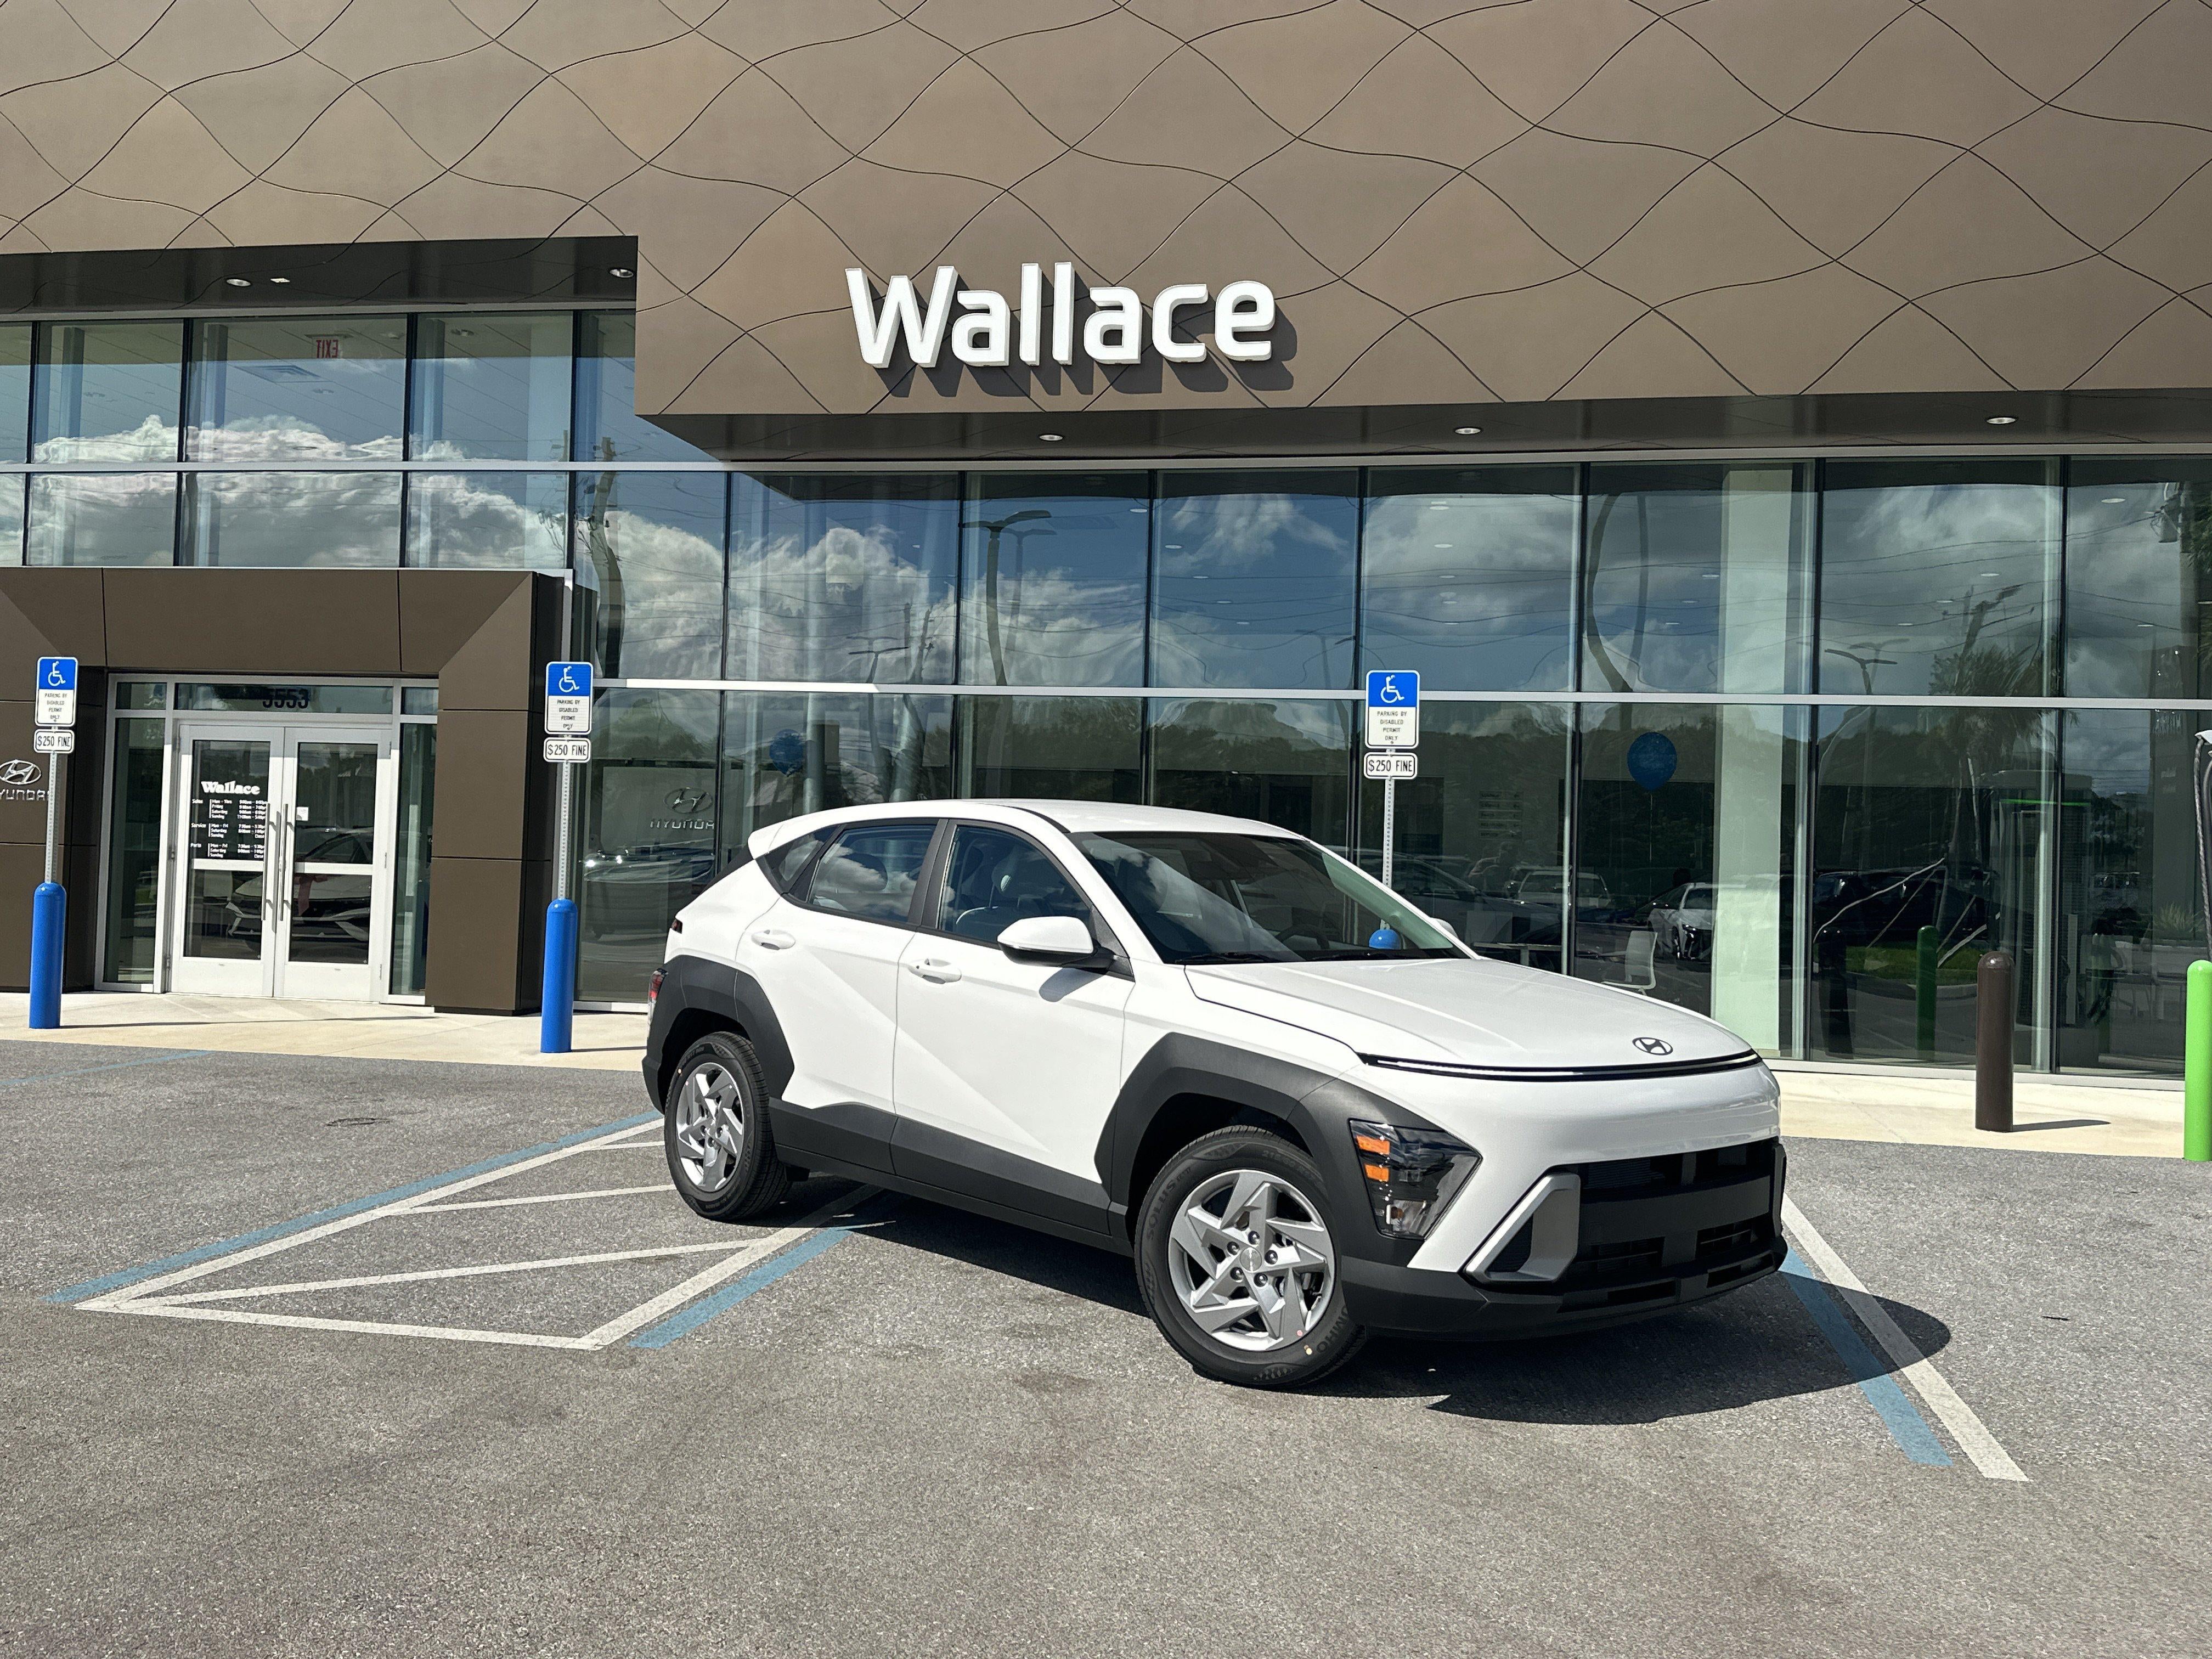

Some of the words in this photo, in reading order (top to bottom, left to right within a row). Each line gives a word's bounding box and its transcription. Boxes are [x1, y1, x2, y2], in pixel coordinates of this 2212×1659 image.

[845, 262, 1276, 368] Wallace
[37, 735, 54, 747] $250
[58, 736, 71, 747] FINE
[548, 744, 568, 756] $250
[571, 744, 586, 756] FINE
[1368, 760, 1391, 772] $250
[1396, 760, 1413, 772] FINE
[201, 780, 261, 795] Wallace
[0, 789, 49, 800] YUNDAI
[650, 819, 714, 830] HYUNDA
